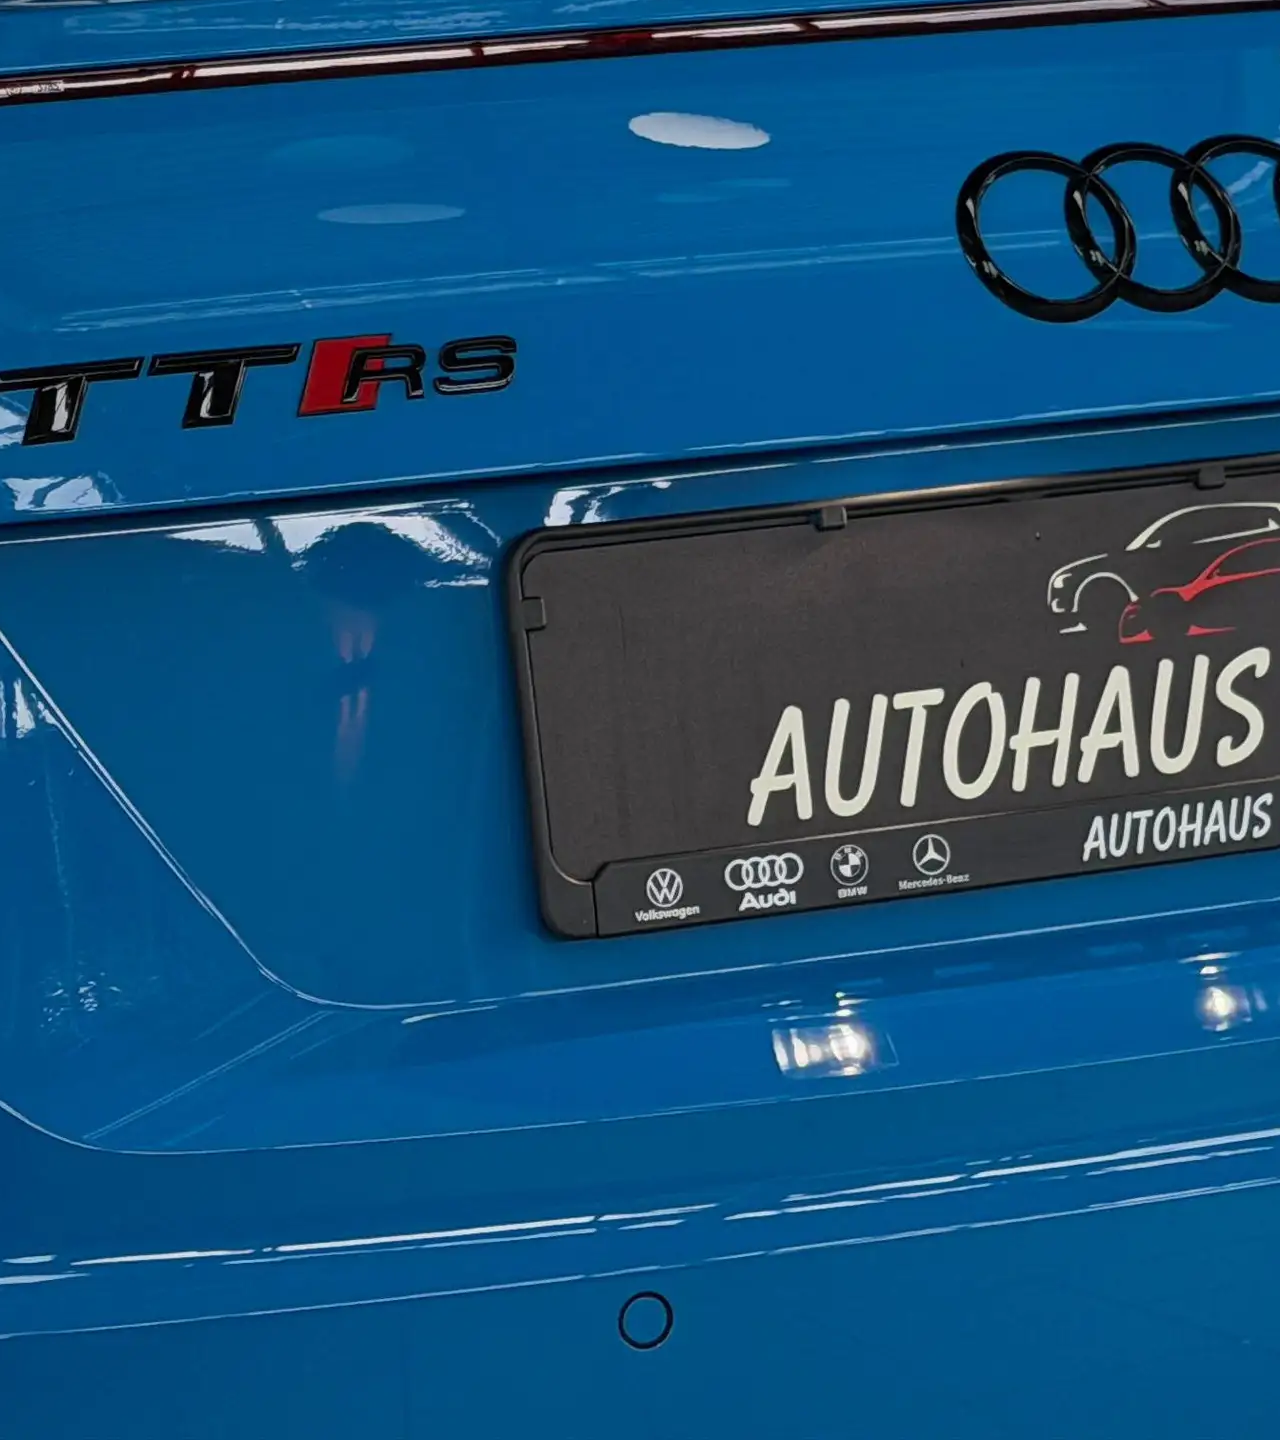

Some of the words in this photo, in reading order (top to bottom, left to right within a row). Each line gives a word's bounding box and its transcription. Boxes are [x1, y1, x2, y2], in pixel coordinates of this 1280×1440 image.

[746, 646, 1271, 828] AUTOHAUS
[1082, 792, 1273, 861] AUTOHAUS
[898, 873, 970, 890] Mercedes-Benz
[739, 890, 797, 911] Audi
[635, 905, 700, 922] Volkswagen
